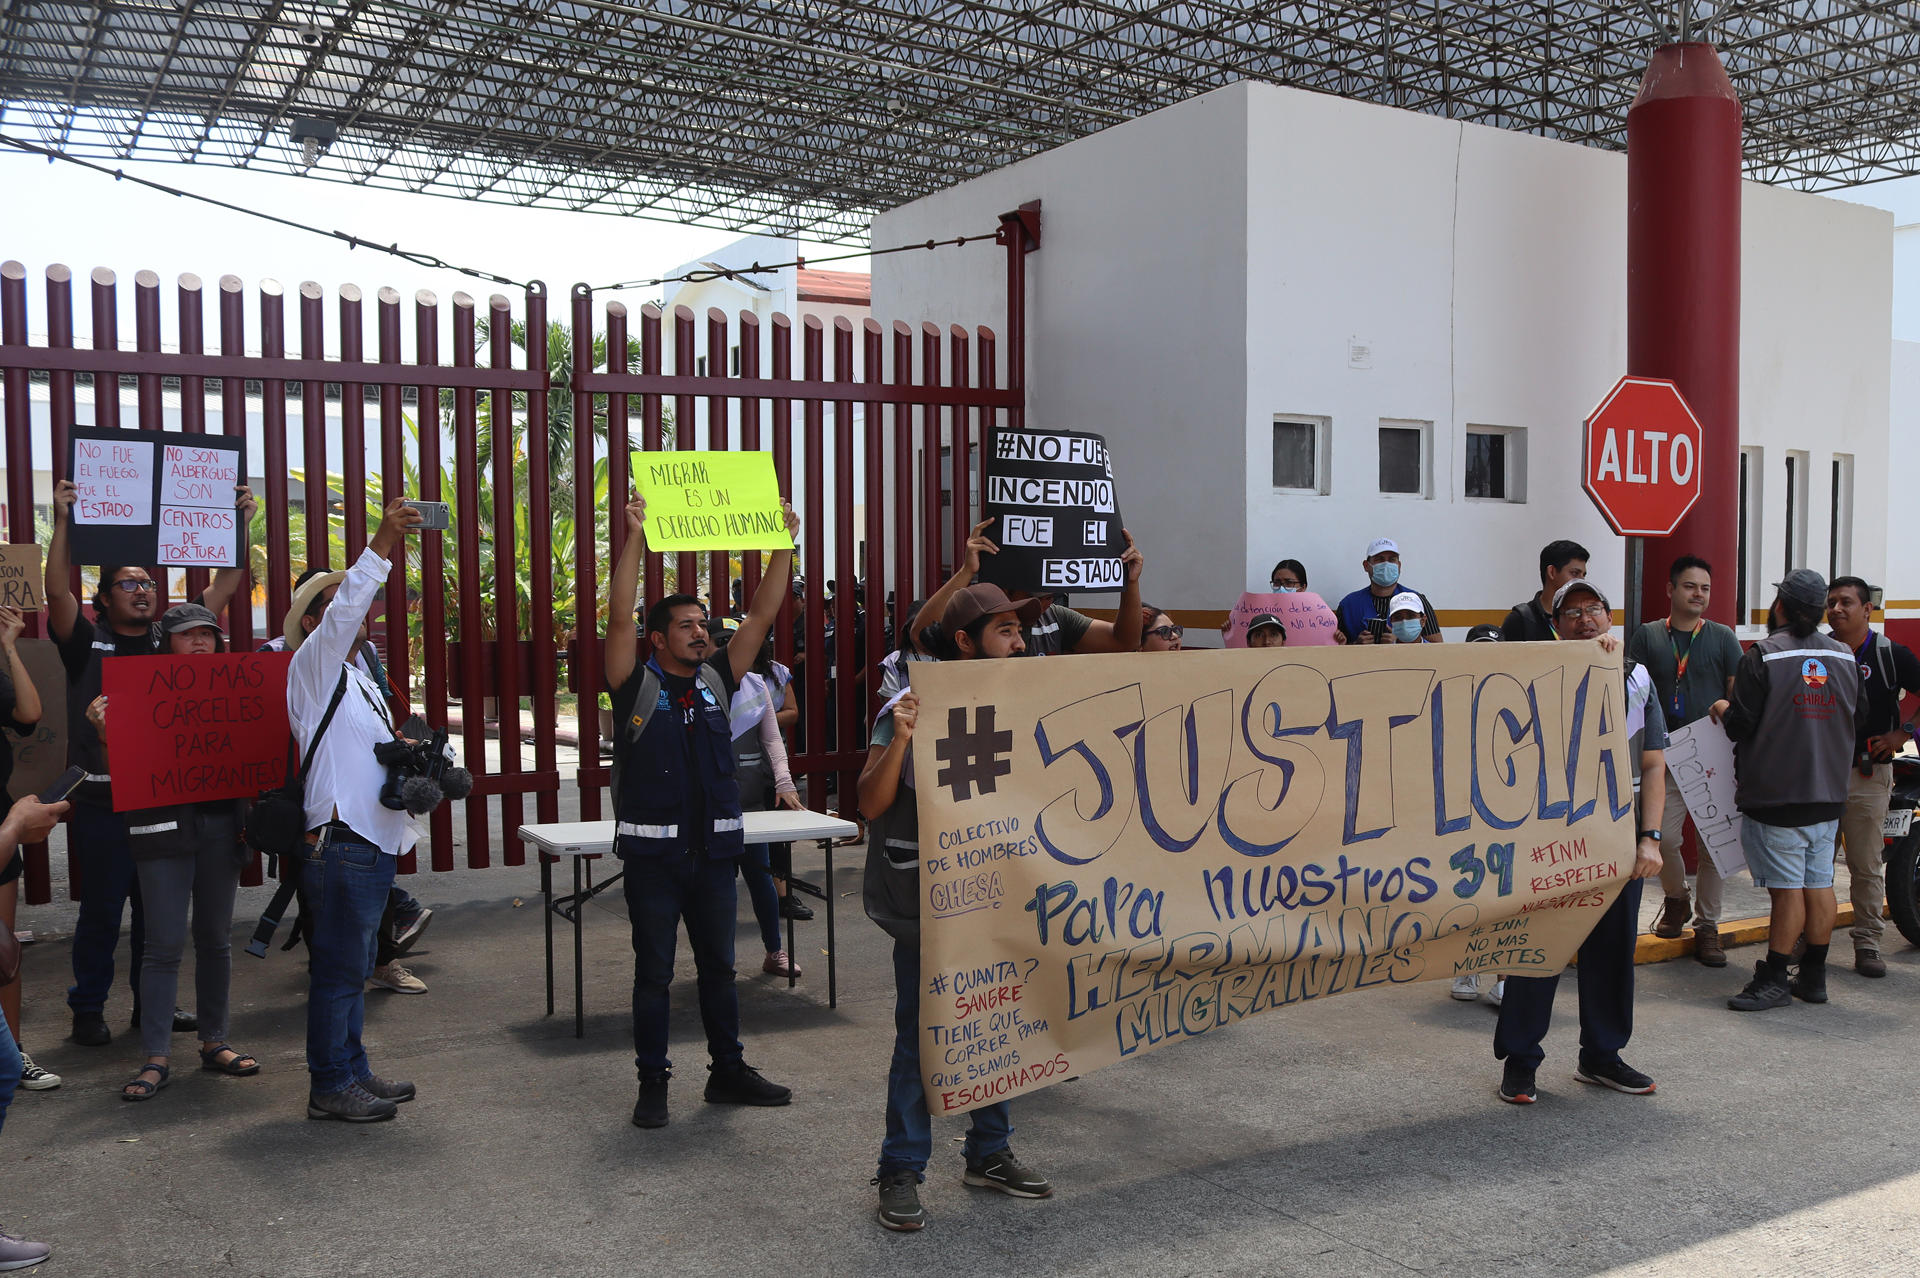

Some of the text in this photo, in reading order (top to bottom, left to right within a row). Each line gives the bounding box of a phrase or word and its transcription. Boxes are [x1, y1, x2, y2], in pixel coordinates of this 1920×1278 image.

[79, 442, 134, 463] NO FUE
[166, 446, 219, 464] NO SON
[998, 434, 1061, 461] #NO
[1069, 438, 1102, 464] FUE
[1597, 428, 1693, 486] ALTO
[80, 463, 140, 479] EL FUEGO,
[650, 461, 710, 488] MIGRAR
[77, 483, 120, 497] FUE EL
[173, 480, 212, 500] SON
[685, 489, 731, 507] ES UN
[991, 477, 1112, 510] INCENDIO,
[80, 499, 133, 519] ESTADO
[162, 508, 234, 530] CENTROS
[183, 532, 200, 546] DE
[656, 509, 786, 540] DERECHO HUMANO
[1008, 518, 1106, 544] FUE EL
[160, 544, 226, 560] TORTURA
[1045, 559, 1122, 584] ESTADO
[148, 656, 264, 694] NO MÁS
[175, 731, 234, 758] PARA
[151, 758, 282, 798] MIGRANTES
[938, 816, 1019, 850] COLECTIVO
[927, 835, 1038, 875] DE HOMBRES
[1530, 837, 1588, 868] #INM
[930, 870, 1005, 912] CHESA
[1529, 861, 1618, 894] RESPETEN
[1024, 876, 1166, 946] Para
[1448, 842, 1516, 899] 39
[1465, 933, 1529, 953] NO MAS
[1453, 948, 1546, 975] MUERTES
[954, 984, 1023, 1020] SANGRE
[927, 1009, 1025, 1046] TIENE QUE
[944, 1019, 1049, 1066] CORRER PARA
[930, 1050, 1020, 1088] QUE SEAMOS
[940, 1052, 1070, 1111] ESCUCHADOS
